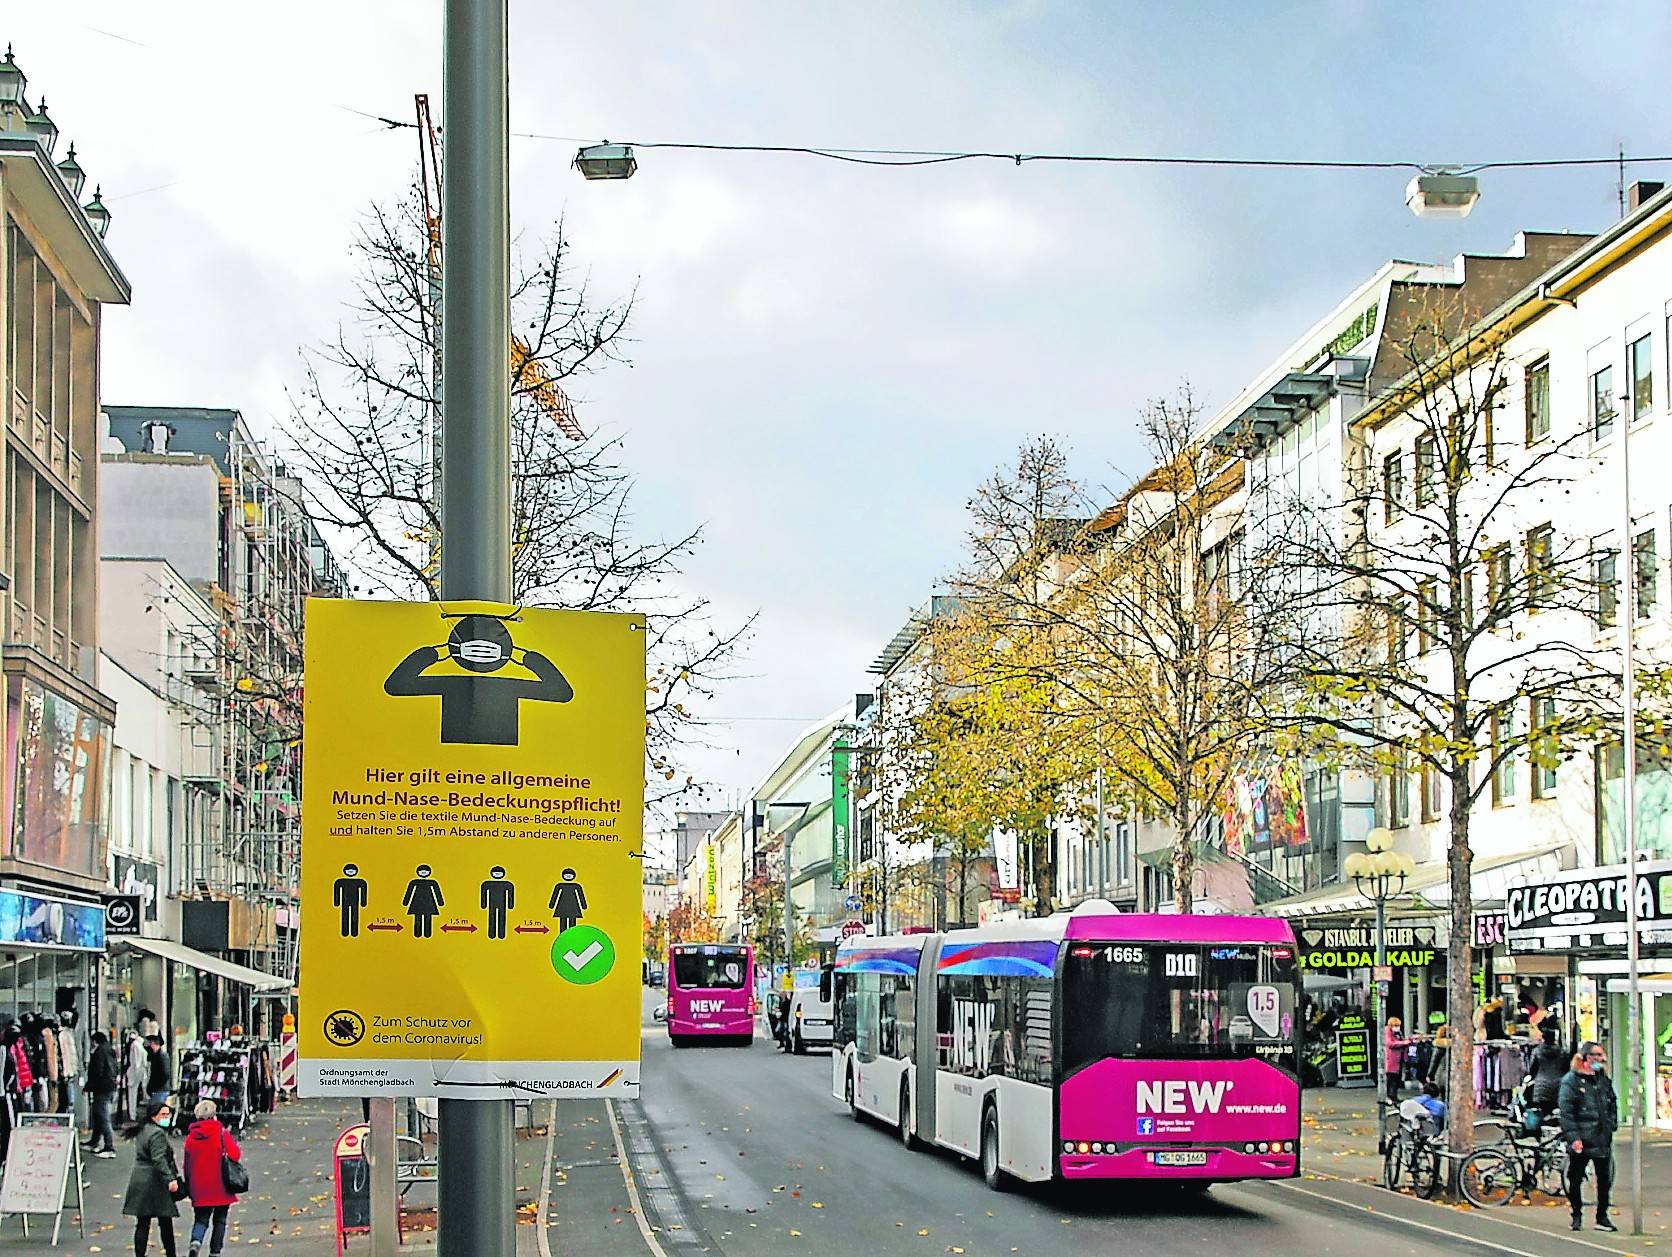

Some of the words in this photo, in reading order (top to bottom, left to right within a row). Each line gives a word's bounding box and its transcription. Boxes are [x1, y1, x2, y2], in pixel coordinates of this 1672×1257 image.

[366, 768, 404, 782] Hier
[410, 769, 440, 786] gilt
[445, 770, 486, 784] eine
[491, 771, 591, 789] allgemeine
[332, 790, 620, 813] Mund-Nase-Bedeckungspflicht!
[337, 810, 375, 820] Setzen
[379, 810, 396, 820] Sie
[400, 810, 417, 821] die
[422, 811, 458, 822] textile
[461, 812, 596, 828] Mund-Nase-Bedeckung
[599, 817, 616, 827] auf
[329, 825, 352, 836] und
[356, 825, 392, 835] halten
[396, 825, 413, 835] Sie
[418, 826, 445, 837] 1,5m
[450, 826, 499, 837] Abstand
[519, 829, 566, 839] anderen
[569, 830, 622, 842] Personen.
[1508, 876, 1655, 929] CLEOPATRA
[843, 926, 865, 937] STOP
[1324, 928, 1368, 947] ISTANBUL
[1103, 946, 1143, 963] 1665
[1165, 953, 1197, 977] D10
[1252, 991, 1275, 1012] 1,5
[373, 1016, 401, 1027] Zum
[406, 1016, 448, 1028] Schutz
[451, 1019, 471, 1028] vor
[372, 1033, 401, 1044] dem
[405, 1033, 482, 1045] Coronavirus!
[319, 1069, 374, 1078] Ordnungsamt
[319, 1078, 340, 1086] Stadt
[342, 1078, 415, 1087] Mönchengladbach
[1225, 1103, 1287, 1114] www.new.de
